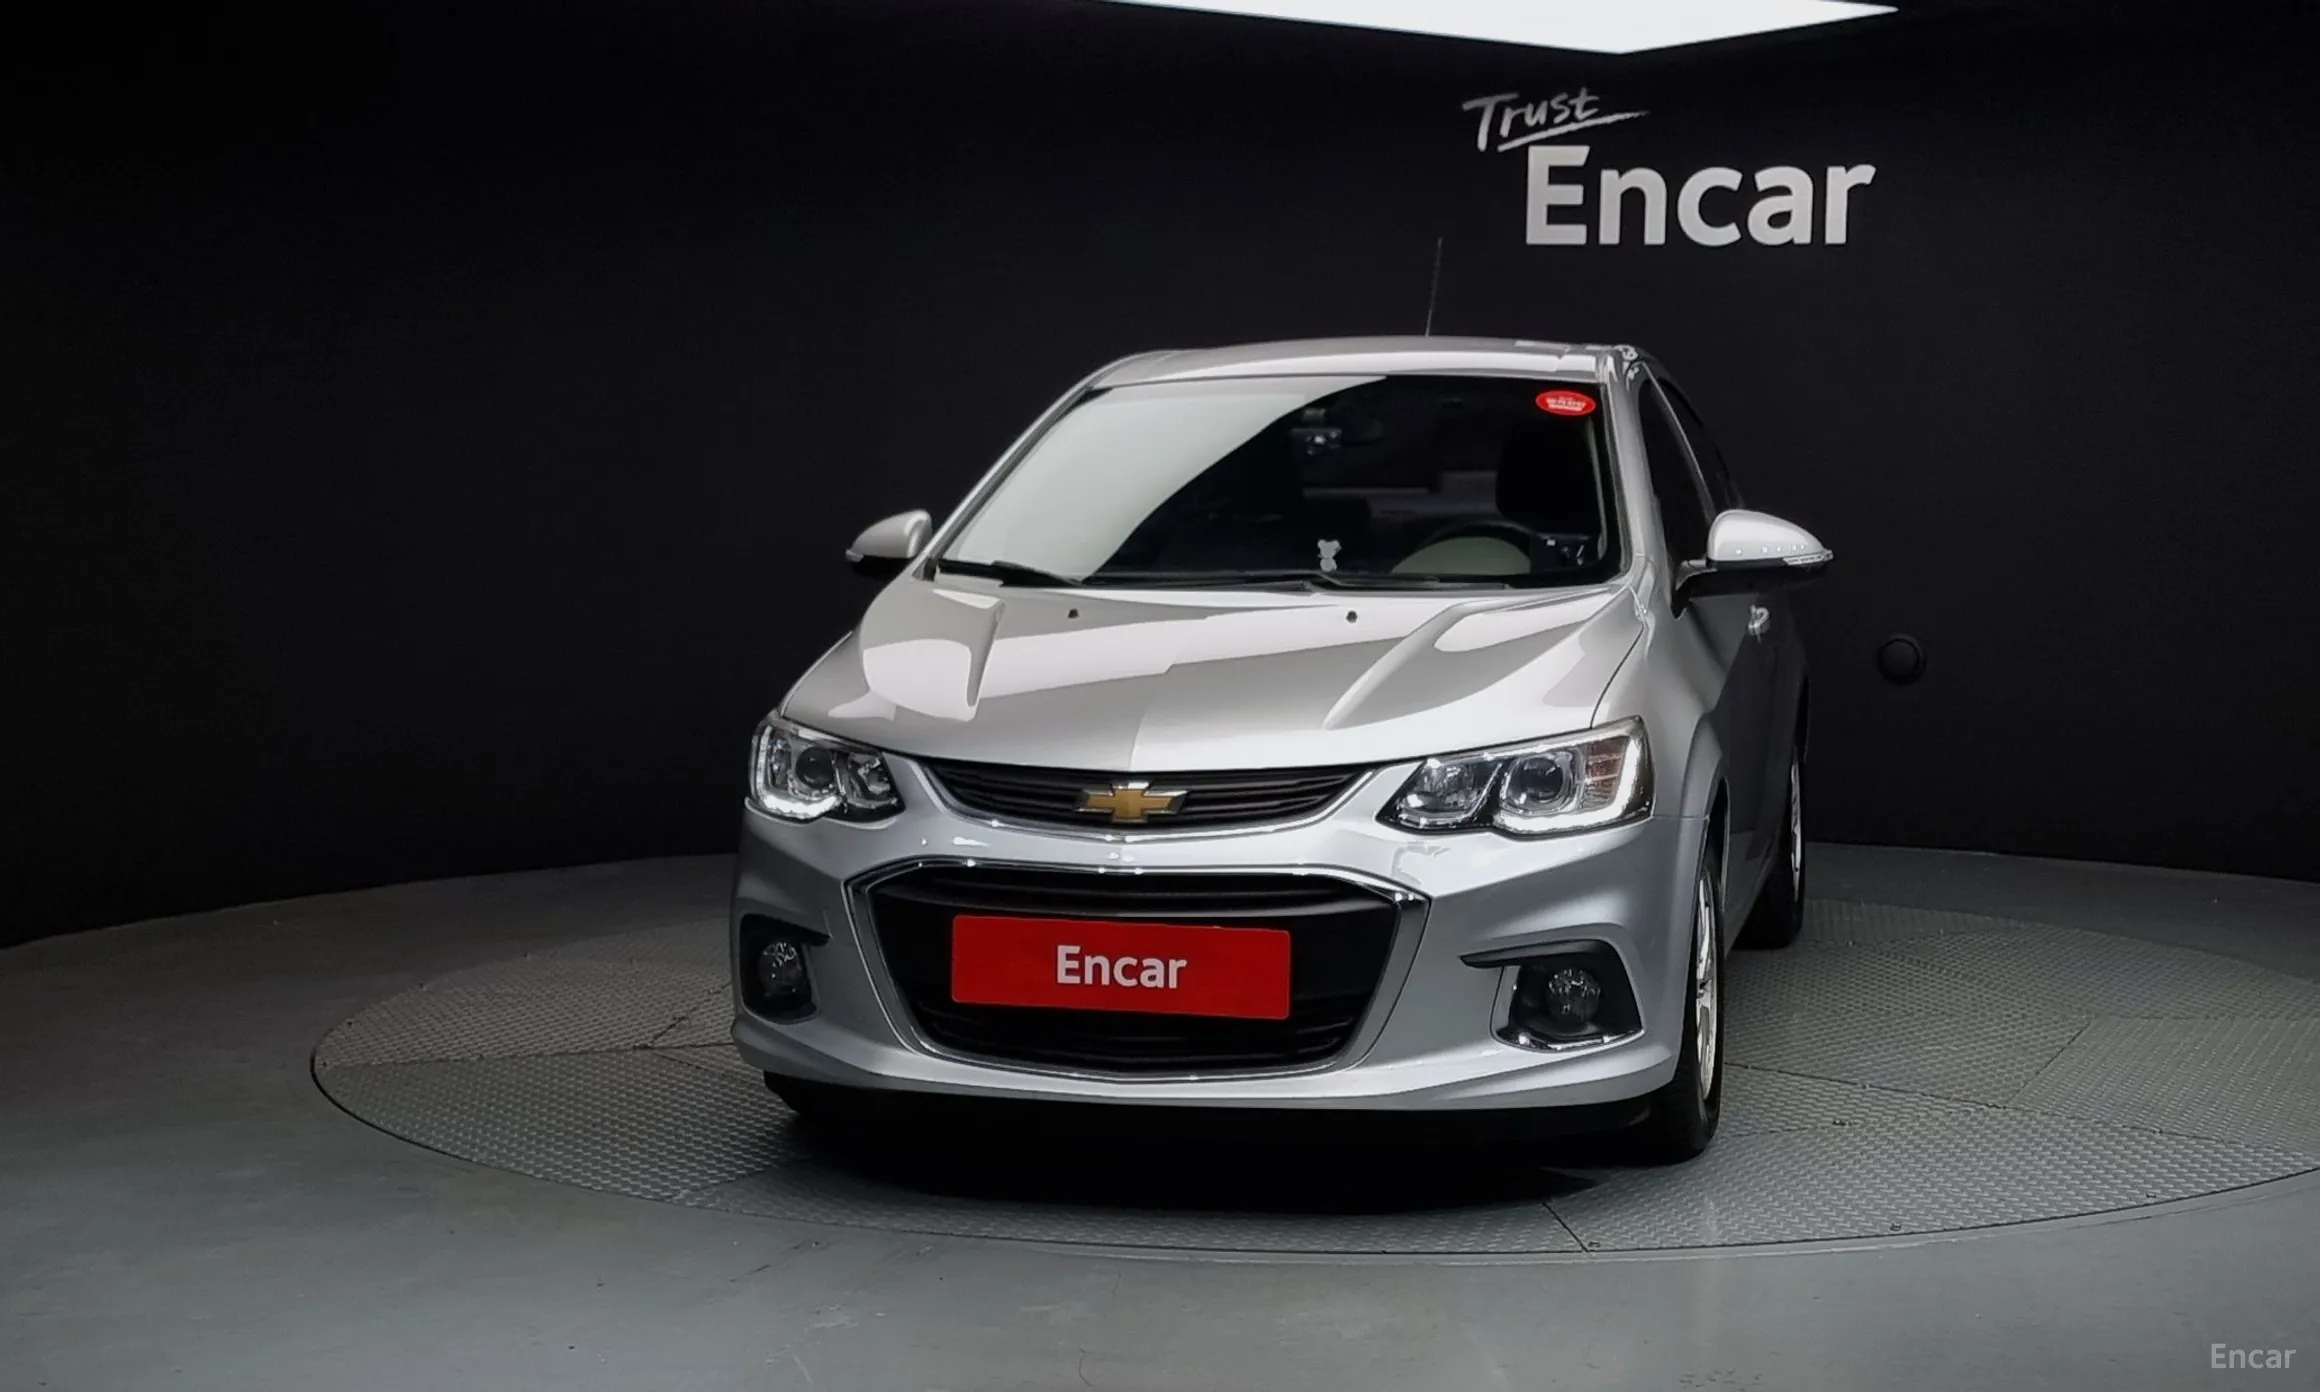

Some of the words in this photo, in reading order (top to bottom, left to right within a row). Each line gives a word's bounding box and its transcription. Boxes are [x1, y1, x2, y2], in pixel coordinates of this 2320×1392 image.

[1462, 87, 1600, 152] Trust
[1525, 145, 1876, 247] Encar
[1056, 944, 1187, 989] Encar
